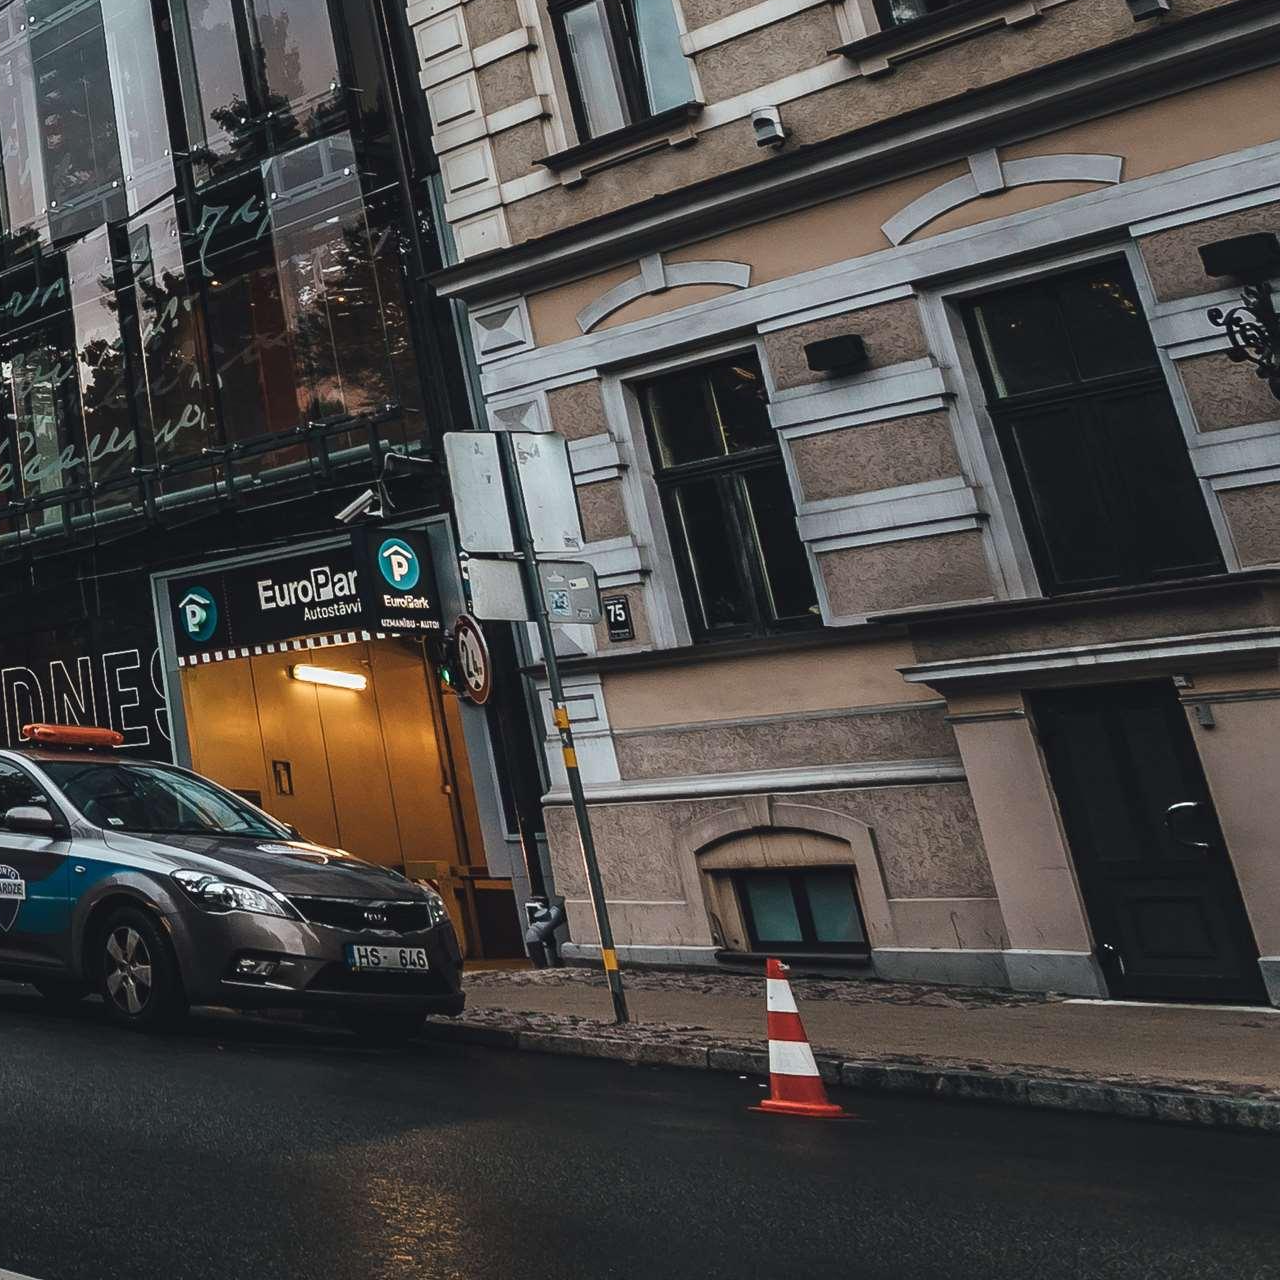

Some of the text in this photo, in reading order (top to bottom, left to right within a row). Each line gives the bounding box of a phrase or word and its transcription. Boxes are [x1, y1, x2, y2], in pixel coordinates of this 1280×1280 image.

[256, 566, 358, 610] EuroPar
[303, 599, 362, 622] Autostāvvi
[382, 594, 430, 609] EuroPark
[606, 604, 626, 622] 75
[399, 948, 427, 969] 646
